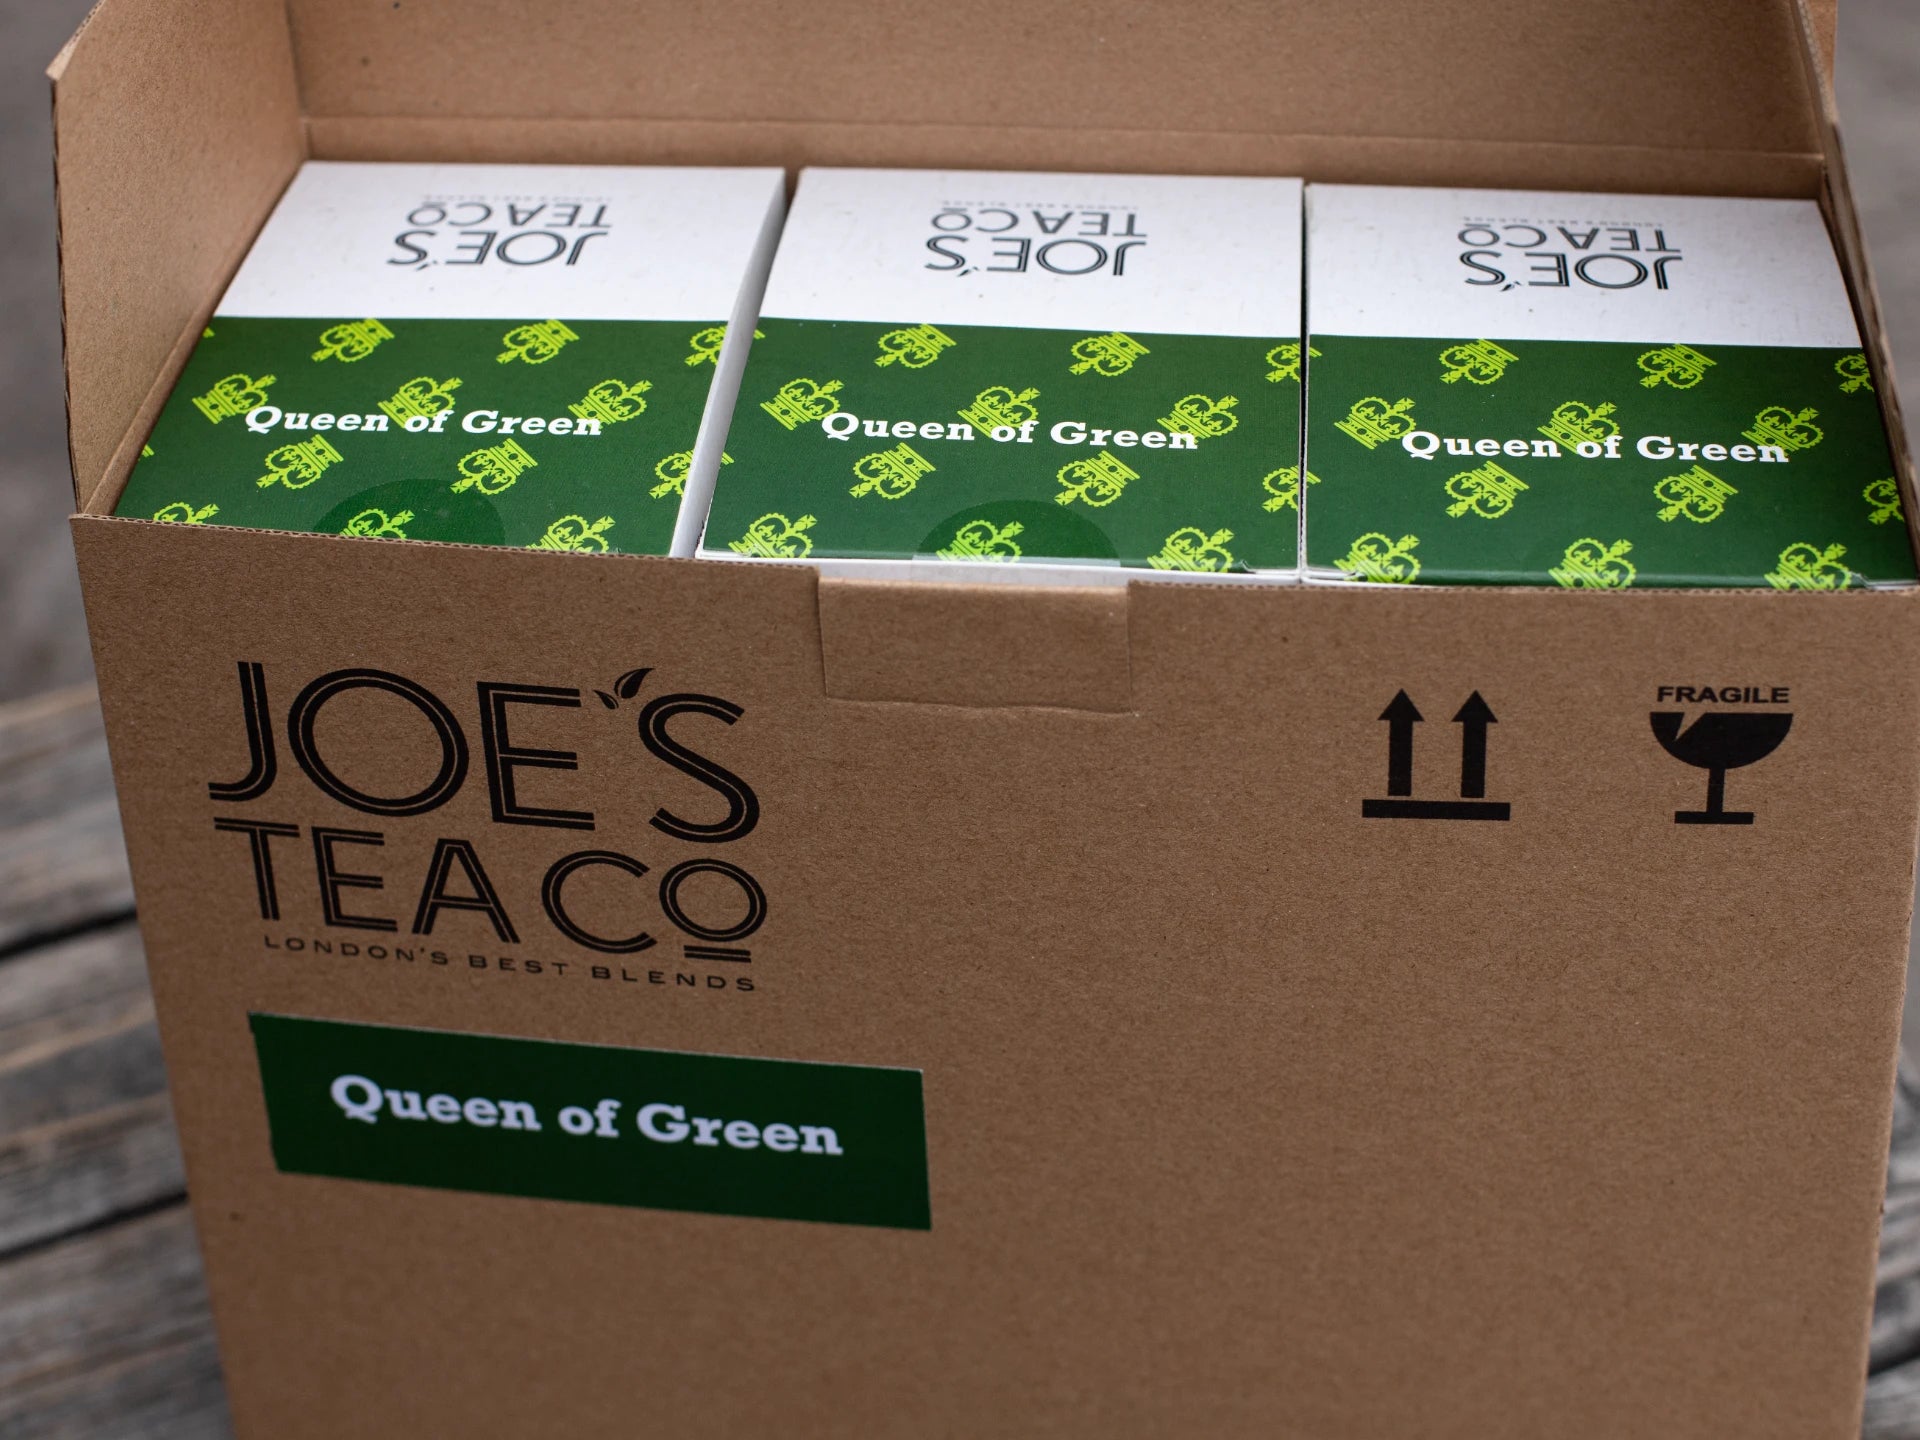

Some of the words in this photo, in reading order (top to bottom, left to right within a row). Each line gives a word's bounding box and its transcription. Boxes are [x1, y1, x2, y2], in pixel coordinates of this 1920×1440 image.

[508, 203, 612, 228] TEA
[1032, 210, 1147, 237] TEA
[386, 230, 609, 271] JOE'S
[924, 235, 1147, 277] JOE'S
[1557, 226, 1681, 253] TEA
[1459, 250, 1683, 292] JOE'S
[245, 405, 389, 434] Queen
[404, 409, 454, 433] of
[461, 409, 601, 436] Green
[821, 412, 975, 441] Queen
[990, 420, 1039, 443] of
[1050, 421, 1198, 450] Green
[1401, 431, 1561, 460] Queen
[1576, 435, 1621, 459] of
[1636, 435, 1789, 463] Green
[1657, 686, 1790, 704] FRAGILE
[208, 661, 760, 843] JOE'S
[214, 817, 520, 944] TEA
[264, 934, 449, 966] LONDON'S
[469, 955, 568, 976] BEST
[592, 966, 756, 992] BLENDS
[331, 1074, 541, 1132] Queen
[558, 1099, 621, 1138] of
[636, 1103, 843, 1156] Green
